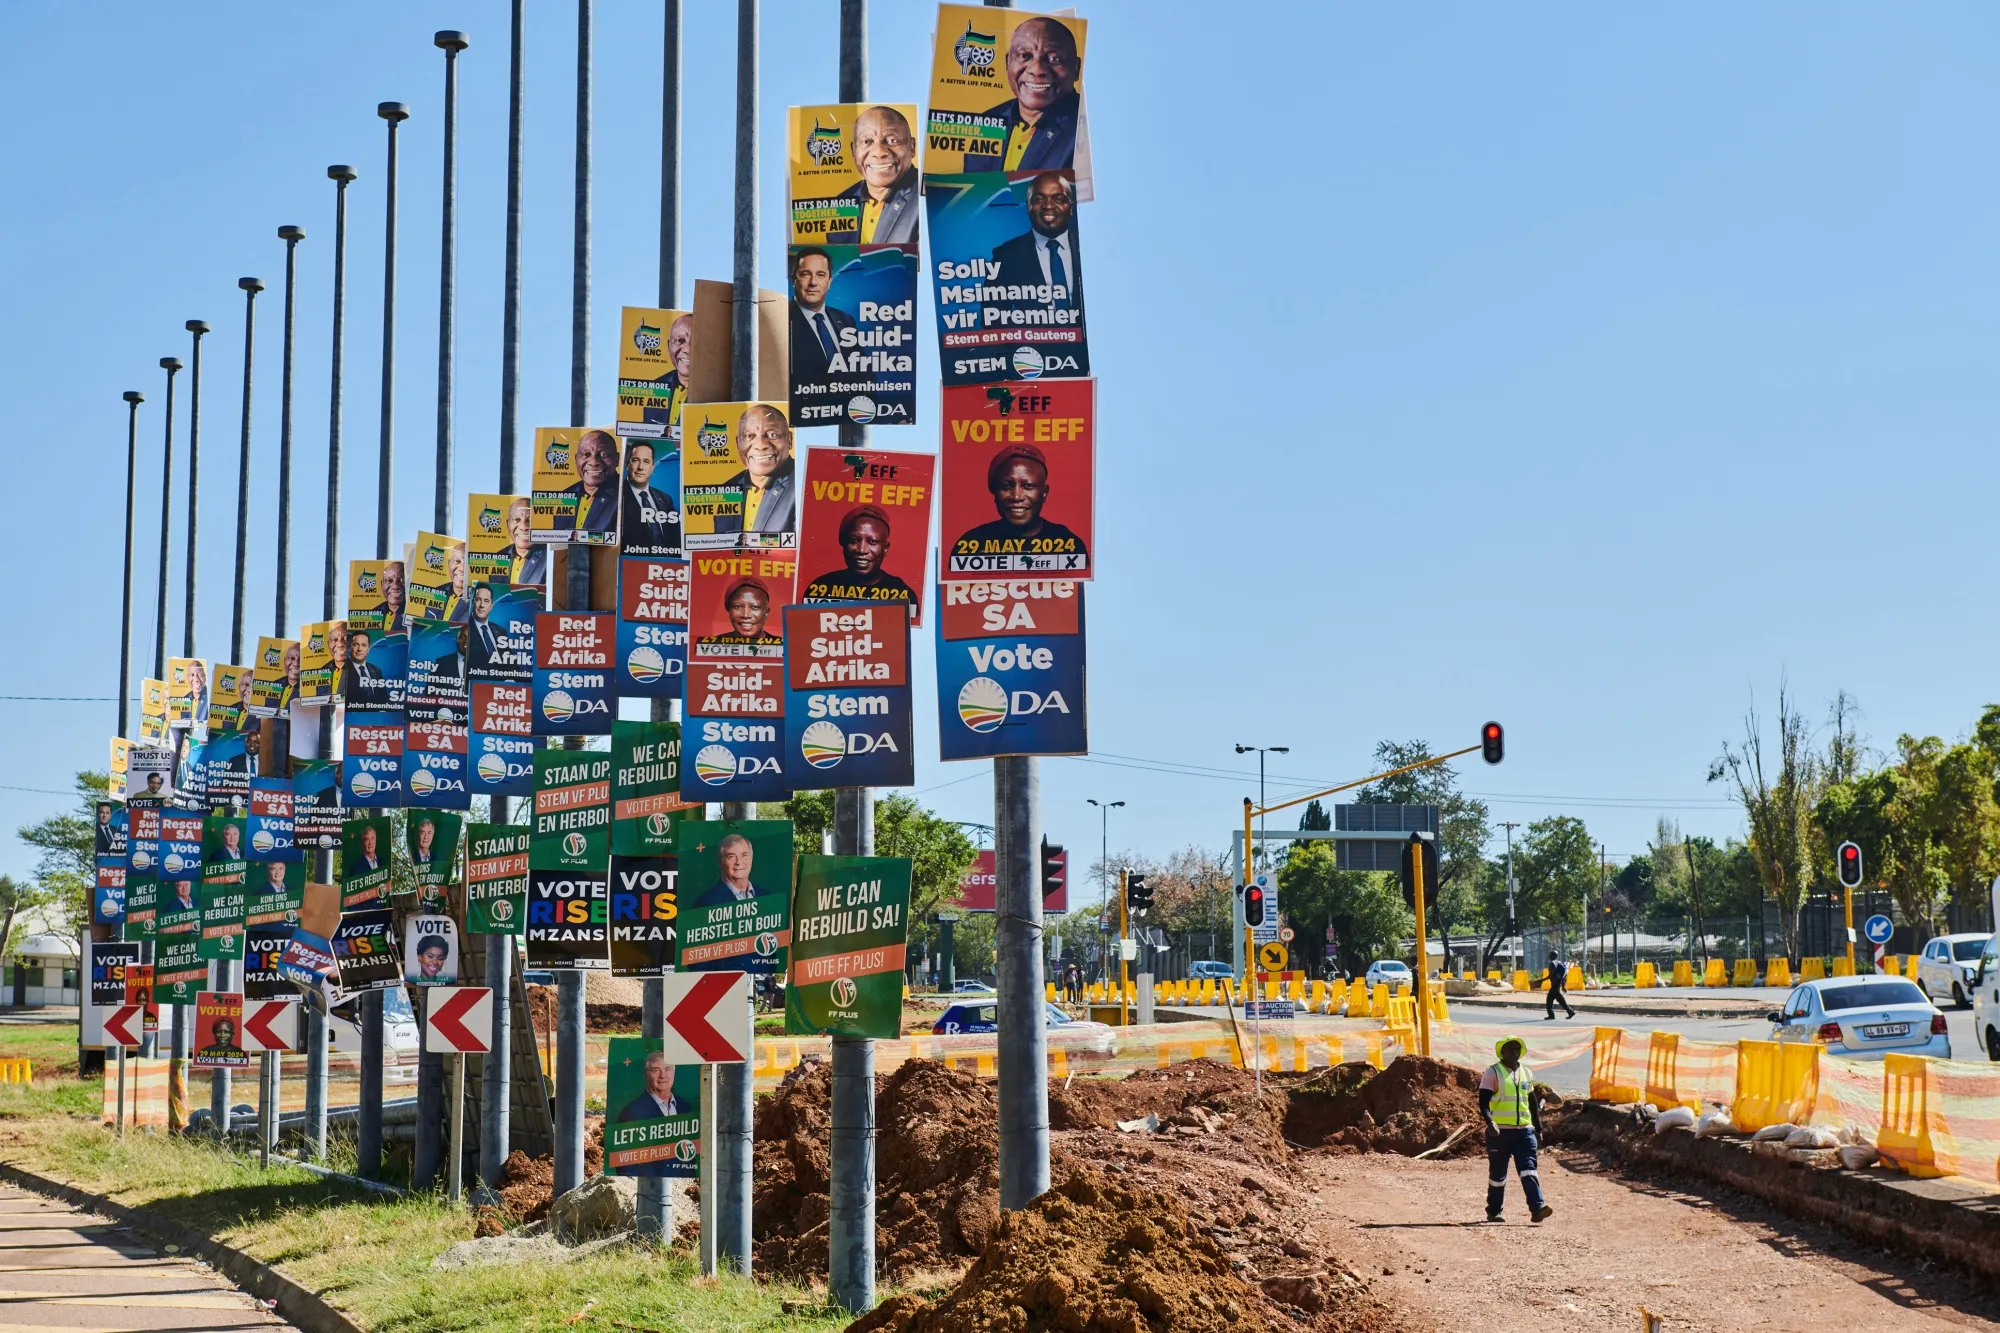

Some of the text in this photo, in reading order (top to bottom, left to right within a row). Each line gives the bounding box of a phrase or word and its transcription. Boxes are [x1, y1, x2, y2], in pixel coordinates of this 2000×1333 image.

[969, 66, 995, 77] ANC
[931, 112, 1006, 130] LET'S DO MORE,
[930, 123, 983, 136] TOGETHER.
[930, 136, 999, 154] VOTE ANC
[821, 156, 843, 166] ANC
[795, 199, 858, 210] LET'S DO MORE,
[796, 219, 854, 234] VOTE ANC
[939, 259, 1001, 280] Solly
[941, 283, 1066, 304] Msimanga
[860, 300, 912, 322] Red
[943, 306, 1079, 328] vir Premier
[840, 326, 912, 347] Suid-
[946, 330, 1076, 345] Stem en red Gauteng
[827, 351, 912, 373] Afrika
[955, 356, 1079, 374] STEM DA
[795, 381, 911, 395] John Steenhuisen
[620, 396, 666, 407] VOTE ANC
[1019, 396, 1051, 411] EFF
[801, 404, 907, 419] STEM DA
[952, 418, 1084, 442] VOTE EFF
[870, 464, 898, 478] EFF
[812, 480, 925, 506] VOTE EFF
[534, 506, 554, 515] VOTE
[687, 504, 738, 515] VOTE ANC
[624, 545, 649, 554] John
[957, 538, 1075, 553] 29 MAY 2024
[698, 559, 796, 578] VOTE EFF
[956, 556, 1007, 570] VOTE
[648, 565, 689, 582] Red
[809, 584, 908, 600] 29 MAY 2024
[947, 582, 1074, 605] Rescue
[560, 617, 596, 631] Red
[820, 609, 872, 632] Red
[982, 603, 1036, 631] SA
[552, 633, 602, 648] Suid-
[810, 634, 882, 658] Suid-
[548, 651, 605, 665] Afrika
[968, 644, 1053, 672] Vote
[409, 660, 439, 672] Solly
[805, 659, 890, 683] Afrika
[548, 673, 604, 688] Stem
[707, 673, 772, 691] Suid-
[494, 687, 526, 701] Red
[575, 700, 608, 713] DA
[701, 694, 777, 712] Afrika
[808, 694, 888, 718] Stem
[1011, 691, 1070, 715] DA
[703, 722, 775, 742] Stem
[367, 741, 390, 753] SA
[427, 735, 453, 749] SA
[483, 737, 533, 753] Stem
[848, 732, 898, 754] DA
[209, 761, 232, 769] Solly
[359, 759, 397, 771] Vote
[419, 754, 460, 769] Vote
[738, 757, 782, 774] DA
[545, 764, 588, 785] STAAN
[619, 762, 676, 786] REBUILD
[377, 780, 401, 791] DA
[436, 778, 465, 791] DA
[295, 795, 319, 804] Solly
[267, 804, 288, 815] SA
[295, 806, 345, 815] Msimanga
[260, 819, 293, 830] Vote
[176, 830, 194, 839] SA
[170, 843, 200, 853] Vote
[475, 837, 514, 856] STAAN
[537, 881, 605, 898] VOTE
[818, 880, 881, 911] WE CAN
[213, 895, 243, 907] WE CAN
[260, 893, 287, 904] KOM ONS
[205, 907, 238, 920] REBUILD
[249, 903, 275, 914] HERSTEL
[530, 900, 607, 923] RISE
[708, 902, 758, 923] KOM ONS
[416, 921, 451, 934] VOTE
[687, 914, 781, 943] HERSTEL EN BOU!
[799, 904, 900, 941] REBUILD SA!
[342, 924, 384, 938] VOTE
[530, 929, 604, 941] MZANS
[167, 943, 196, 955] WE CAN
[333, 935, 388, 956] RISE
[689, 941, 747, 960] STEM VF PLUS!
[97, 956, 133, 965] VOTE
[159, 955, 190, 967] REBUILD
[339, 954, 393, 970] MZANSI
[808, 952, 884, 978] VOTE FF PLUS!
[200, 1006, 227, 1016] VOTE
[614, 1119, 699, 1145] LET'S REBUILD
[619, 1147, 671, 1162] VOTE FF PLUS!
